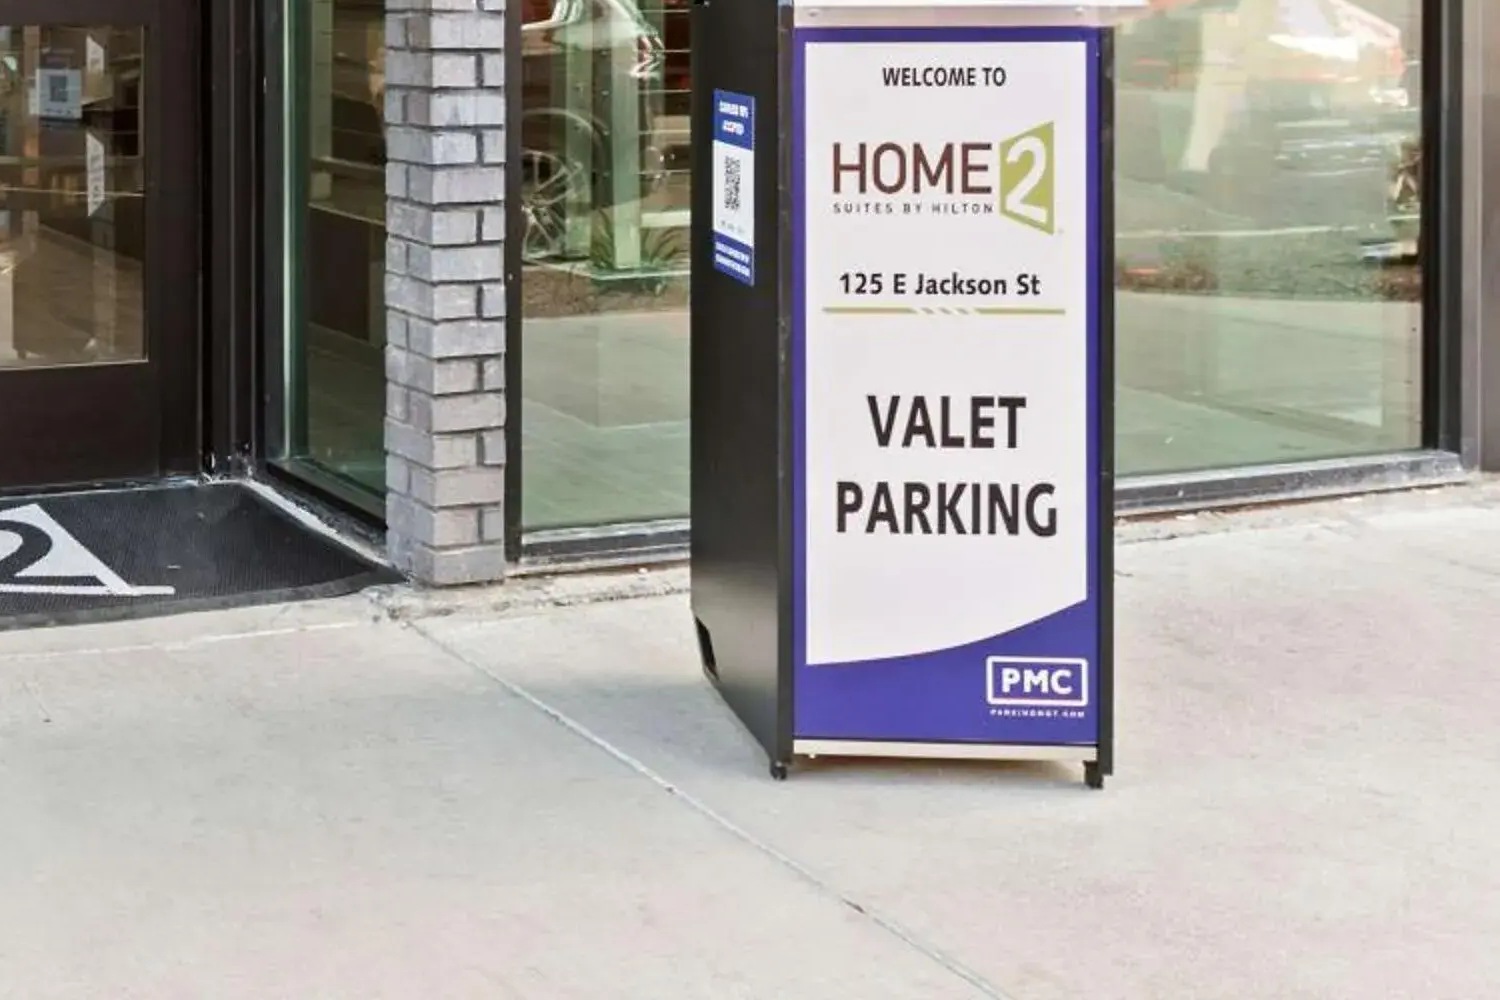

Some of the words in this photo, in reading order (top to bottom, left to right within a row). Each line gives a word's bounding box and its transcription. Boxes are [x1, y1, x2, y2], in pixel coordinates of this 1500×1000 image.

[882, 67, 976, 87] WELCOME
[983, 67, 1006, 87] TO
[832, 142, 993, 194] HOME
[1005, 134, 1049, 225] 2
[833, 203, 894, 214] SUITES
[903, 203, 922, 214] BY
[932, 203, 994, 215] HILTON
[839, 273, 883, 295] 125
[893, 273, 907, 295] E
[915, 271, 1007, 295] Jackson
[1016, 273, 1041, 295] St
[867, 395, 1028, 449] VALET
[835, 481, 1058, 538] PARKING
[1001, 667, 1072, 695] PMC
